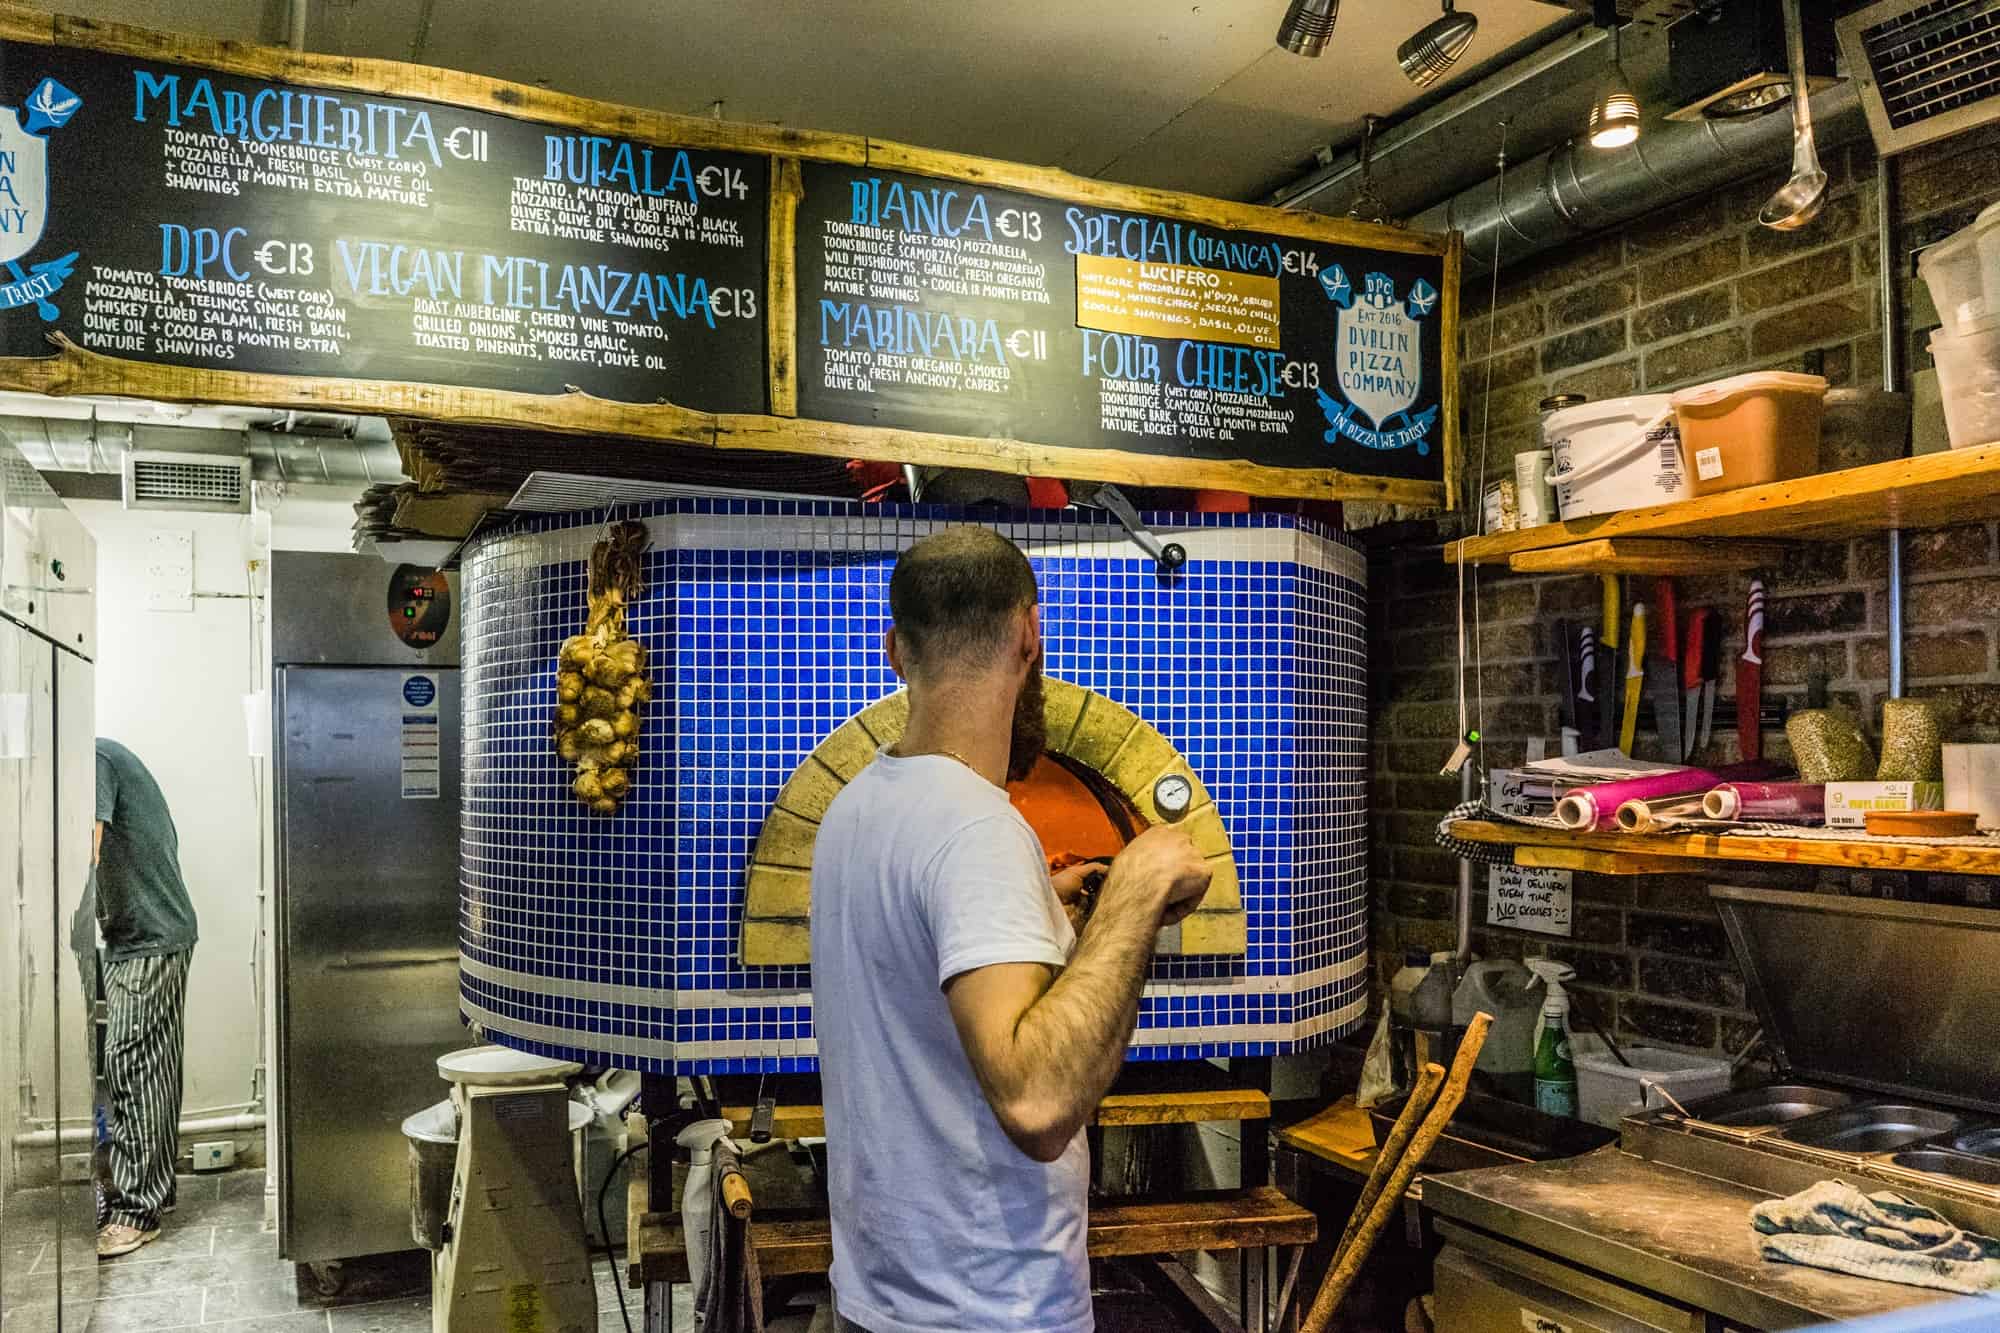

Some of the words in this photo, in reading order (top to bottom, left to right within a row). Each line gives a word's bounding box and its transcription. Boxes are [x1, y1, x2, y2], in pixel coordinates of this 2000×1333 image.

[133, 70, 442, 168] MARGHERITA
[443, 127, 488, 162] €11
[164, 129, 235, 153] TOMATO,
[237, 139, 340, 165] TOONSBRIDGE
[346, 151, 383, 169] (WEST
[388, 160, 426, 177] CORK)
[164, 144, 260, 171] MOZZARELLA,
[268, 158, 305, 175] FRESH
[312, 163, 357, 185] BASIL,
[363, 172, 402, 187] OLIVE
[411, 178, 433, 192] OIL
[544, 135, 698, 204] BUFALA
[696, 166, 749, 200] €14
[165, 172, 240, 196] SHAVINGS
[180, 160, 230, 180] COOLEA
[237, 168, 248, 183] 18
[253, 171, 308, 190] MONTH
[314, 179, 363, 198] EXTRA
[367, 189, 428, 207] MATURE
[513, 177, 572, 198] TOMATO,
[577, 187, 642, 208] MACROOM
[648, 196, 698, 216] BUFFALO
[511, 190, 592, 216] MOZZARELLA,
[596, 203, 618, 218] DRY
[624, 206, 660, 225] CURED
[666, 210, 700, 230] HAM,
[703, 217, 738, 234] BLACK
[511, 205, 555, 224] OLIVES,
[559, 210, 591, 227] OLIVE
[596, 216, 616, 230] OIL
[634, 222, 679, 239] COOLEA
[700, 231, 744, 248] MONTH
[850, 178, 993, 241] BIANCA
[995, 209, 1042, 241] €13
[159, 223, 251, 281] DPC
[254, 240, 314, 275] €13
[511, 217, 549, 236] EXTRA
[553, 224, 604, 242] MATURE
[611, 232, 670, 251] SHAVINGS
[823, 220, 895, 242] TOONSBRIDGE
[931, 236, 961, 252] CORK)
[964, 241, 1032, 263] MOZZARELLA,
[823, 235, 894, 256] TOONSBRIDGE
[898, 244, 952, 265] SCAMORZA
[823, 251, 849, 266] WILD
[853, 255, 920, 276] MUSHROOMS,
[923, 262, 964, 282] GARLIC,
[965, 265, 993, 282] FRESH
[1140, 264, 1220, 288] LUCIFERO
[1282, 251, 1319, 277] €14
[1, 273, 53, 305] TRUST
[86, 281, 184, 308] MOZZARELLA,
[186, 293, 249, 312] TEELINGS
[254, 300, 300, 317] SINGLE
[306, 305, 346, 322] GRAIN
[92, 266, 160, 289] TOMATO,
[162, 276, 255, 298] TOONSBRIDGE
[258, 282, 296, 300] (WEST
[298, 289, 334, 308] CORK)
[335, 240, 464, 300] VEGAN
[482, 255, 716, 328] MELANZANA
[709, 287, 757, 319] €13
[823, 280, 865, 296] MATURE
[870, 284, 920, 302] SHAVINGS
[824, 265, 869, 284] ROCKET,
[871, 270, 899, 286] OLIVE
[903, 275, 919, 288] OIL
[931, 277, 968, 294] COOLEA
[983, 284, 1018, 300] MONTH
[1021, 289, 1050, 304] EXTRA
[1367, 278, 1391, 294] DPC
[83, 313, 120, 332] OLIVE
[124, 319, 147, 335] OIL
[164, 322, 217, 341] COOLEA
[238, 331, 289, 349] MONTH
[294, 337, 340, 355] EXTRA
[85, 298, 148, 318] WHISKEY
[155, 305, 197, 322] CURED
[203, 311, 262, 331] SALAMI,
[266, 317, 302, 333] FRESH
[310, 321, 350, 339] BASIL,
[413, 315, 461, 333] GRILLED
[469, 321, 524, 343] ONIONS,
[529, 328, 578, 346] SMOKED
[583, 334, 634, 354] GARLIC,
[414, 298, 449, 313] ROAST
[454, 303, 528, 327] AUBERGINE,
[531, 311, 575, 329] CHERRY
[580, 316, 608, 332] VINE
[612, 321, 668, 341] TOMATO,
[819, 299, 1008, 366] MARINARA
[1005, 329, 1047, 360] €11
[1237, 322, 1270, 334] OLIVE
[83, 332, 145, 351] MATURE
[155, 338, 235, 359] SHAVINGS
[412, 332, 469, 351] TOASTED
[476, 338, 542, 360] PINENUTS,
[548, 347, 601, 367] ROCKET,
[604, 352, 640, 367] OLIVE
[645, 356, 666, 369] OIL
[1254, 334, 1276, 344] OIL
[823, 348, 875, 368] TOMATO,
[877, 353, 907, 369] FRESH
[911, 358, 967, 376] OREGANO,
[968, 362, 1010, 379] SMOKED
[824, 362, 867, 380] GARLIC,
[869, 367, 900, 382] FRESH
[905, 370, 961, 391] ANCHOVY,
[964, 378, 1000, 392] CAPERS
[1081, 328, 1161, 383] FOUR
[1176, 340, 1285, 398] CHEESE
[1281, 361, 1319, 389] €13
[1350, 351, 1405, 377] PIZZA
[824, 375, 853, 391] OLIVE
[857, 378, 875, 392] OIL
[1100, 377, 1161, 396] TOONSBRIDGE
[1215, 391, 1272, 409] MOZZARELLA,
[1343, 371, 1416, 398] COMPANY
[1100, 391, 1161, 409] TOONSBRIDGE
[1164, 398, 1212, 414] SCAMORZA
[1101, 403, 1146, 420] HUMMING
[1178, 412, 1210, 427] COOLEA
[1223, 417, 1256, 431] MONTH
[1260, 421, 1288, 434] EXTRA
[1143, 421, 1177, 436] ROCKET
[1189, 426, 1215, 439] OLIVE
[1219, 429, 1235, 441] OIL
[1333, 412, 1347, 429] IN
[1348, 423, 1378, 448] PIZZA
[1381, 434, 1395, 448] WE
[1399, 421, 1427, 445] TRUST
[1497, 902, 1516, 918] NO
